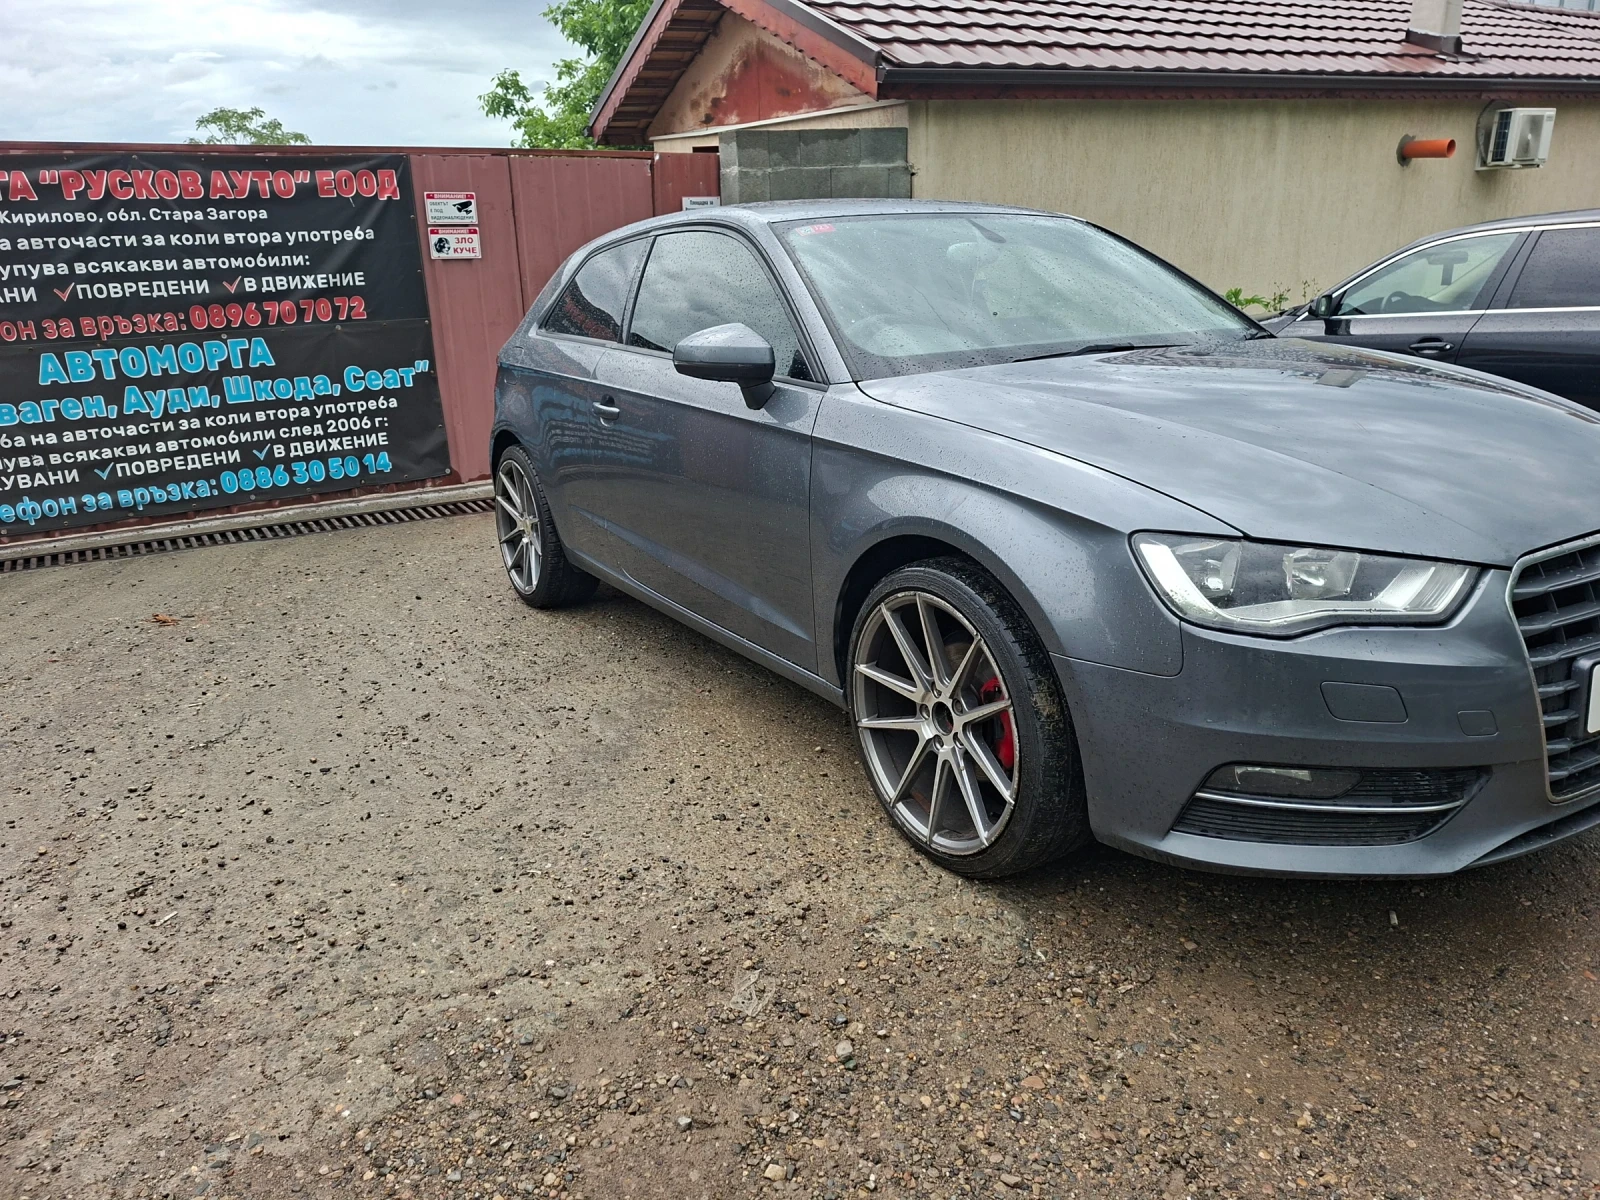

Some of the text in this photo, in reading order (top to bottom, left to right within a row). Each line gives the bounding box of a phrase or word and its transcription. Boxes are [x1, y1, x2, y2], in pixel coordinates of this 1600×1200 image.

[39, 169, 204, 201] "РУСКОВ
[209, 169, 310, 199] АУТО"
[315, 169, 400, 201] ЕООД
[0, 207, 268, 227] Кирилово, обл. Стара Загора
[16, 234, 138, 250] авточасти
[142, 234, 166, 247] за
[170, 232, 220, 246] коли
[224, 231, 282, 247] втора
[285, 226, 375, 246] употреба
[454, 236, 474, 244] ЗЛО
[74, 258, 178, 274] всякакви
[182, 253, 310, 270] автомобили:
[76, 279, 210, 300] ПОВРЕДЕНИ
[243, 277, 257, 292] В
[261, 272, 366, 293] ДВИЖЕНИЕ
[42, 318, 76, 340] за
[80, 311, 187, 340] връзка:
[188, 302, 262, 330] 0896
[262, 300, 298, 326] 70
[300, 298, 333, 322] 70
[334, 296, 367, 320] 72
[38, 336, 276, 386] АВТОМОРГА
[123, 385, 220, 420] Ауди,
[222, 374, 342, 404] Шкода,
[343, 359, 430, 393] Сеат"
[30, 431, 58, 446] на
[62, 420, 174, 444] авточасти
[178, 416, 201, 431] за
[204, 410, 252, 428] коли
[255, 404, 310, 423] втора
[313, 395, 398, 419] употреба
[49, 442, 151, 466] всякакви
[156, 430, 276, 454] автомобили
[279, 422, 324, 439] след
[326, 414, 371, 434] 2006
[374, 414, 389, 428] г:
[0, 432, 389, 492] УВАНИ ПОВРЕДЕНИ В ДВИЖЕНИЕ
[81, 491, 114, 512] за
[118, 478, 219, 511] връзка:
[220, 464, 290, 494] 0886
[291, 459, 326, 485] 30
[328, 455, 360, 480] 50
[362, 451, 392, 475] 14
